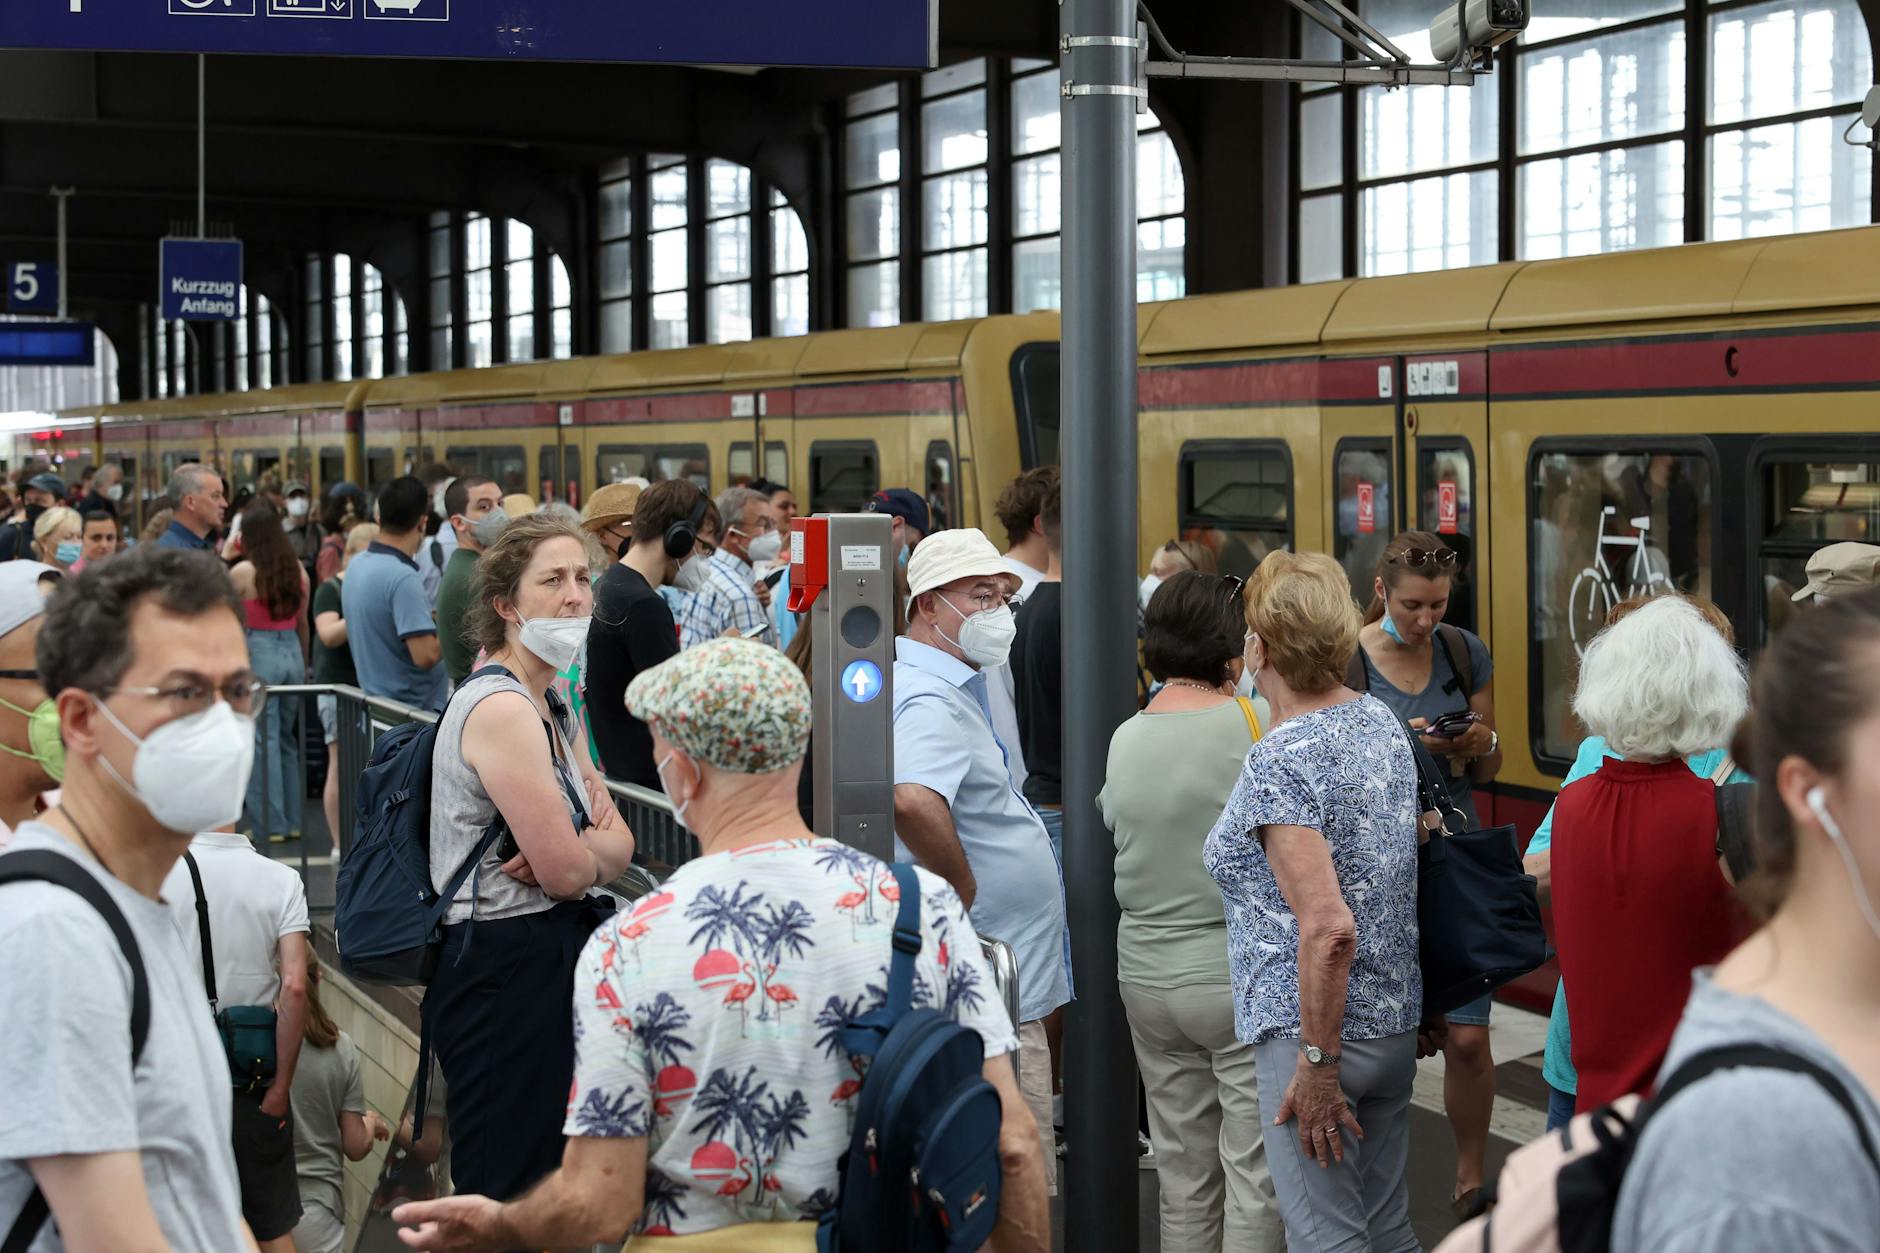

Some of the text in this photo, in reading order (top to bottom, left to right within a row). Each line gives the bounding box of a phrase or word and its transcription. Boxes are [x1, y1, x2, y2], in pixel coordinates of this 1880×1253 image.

[14, 263, 39, 301] 5
[171, 277, 235, 298] Kurzzug
[180, 297, 235, 317] Anfang
